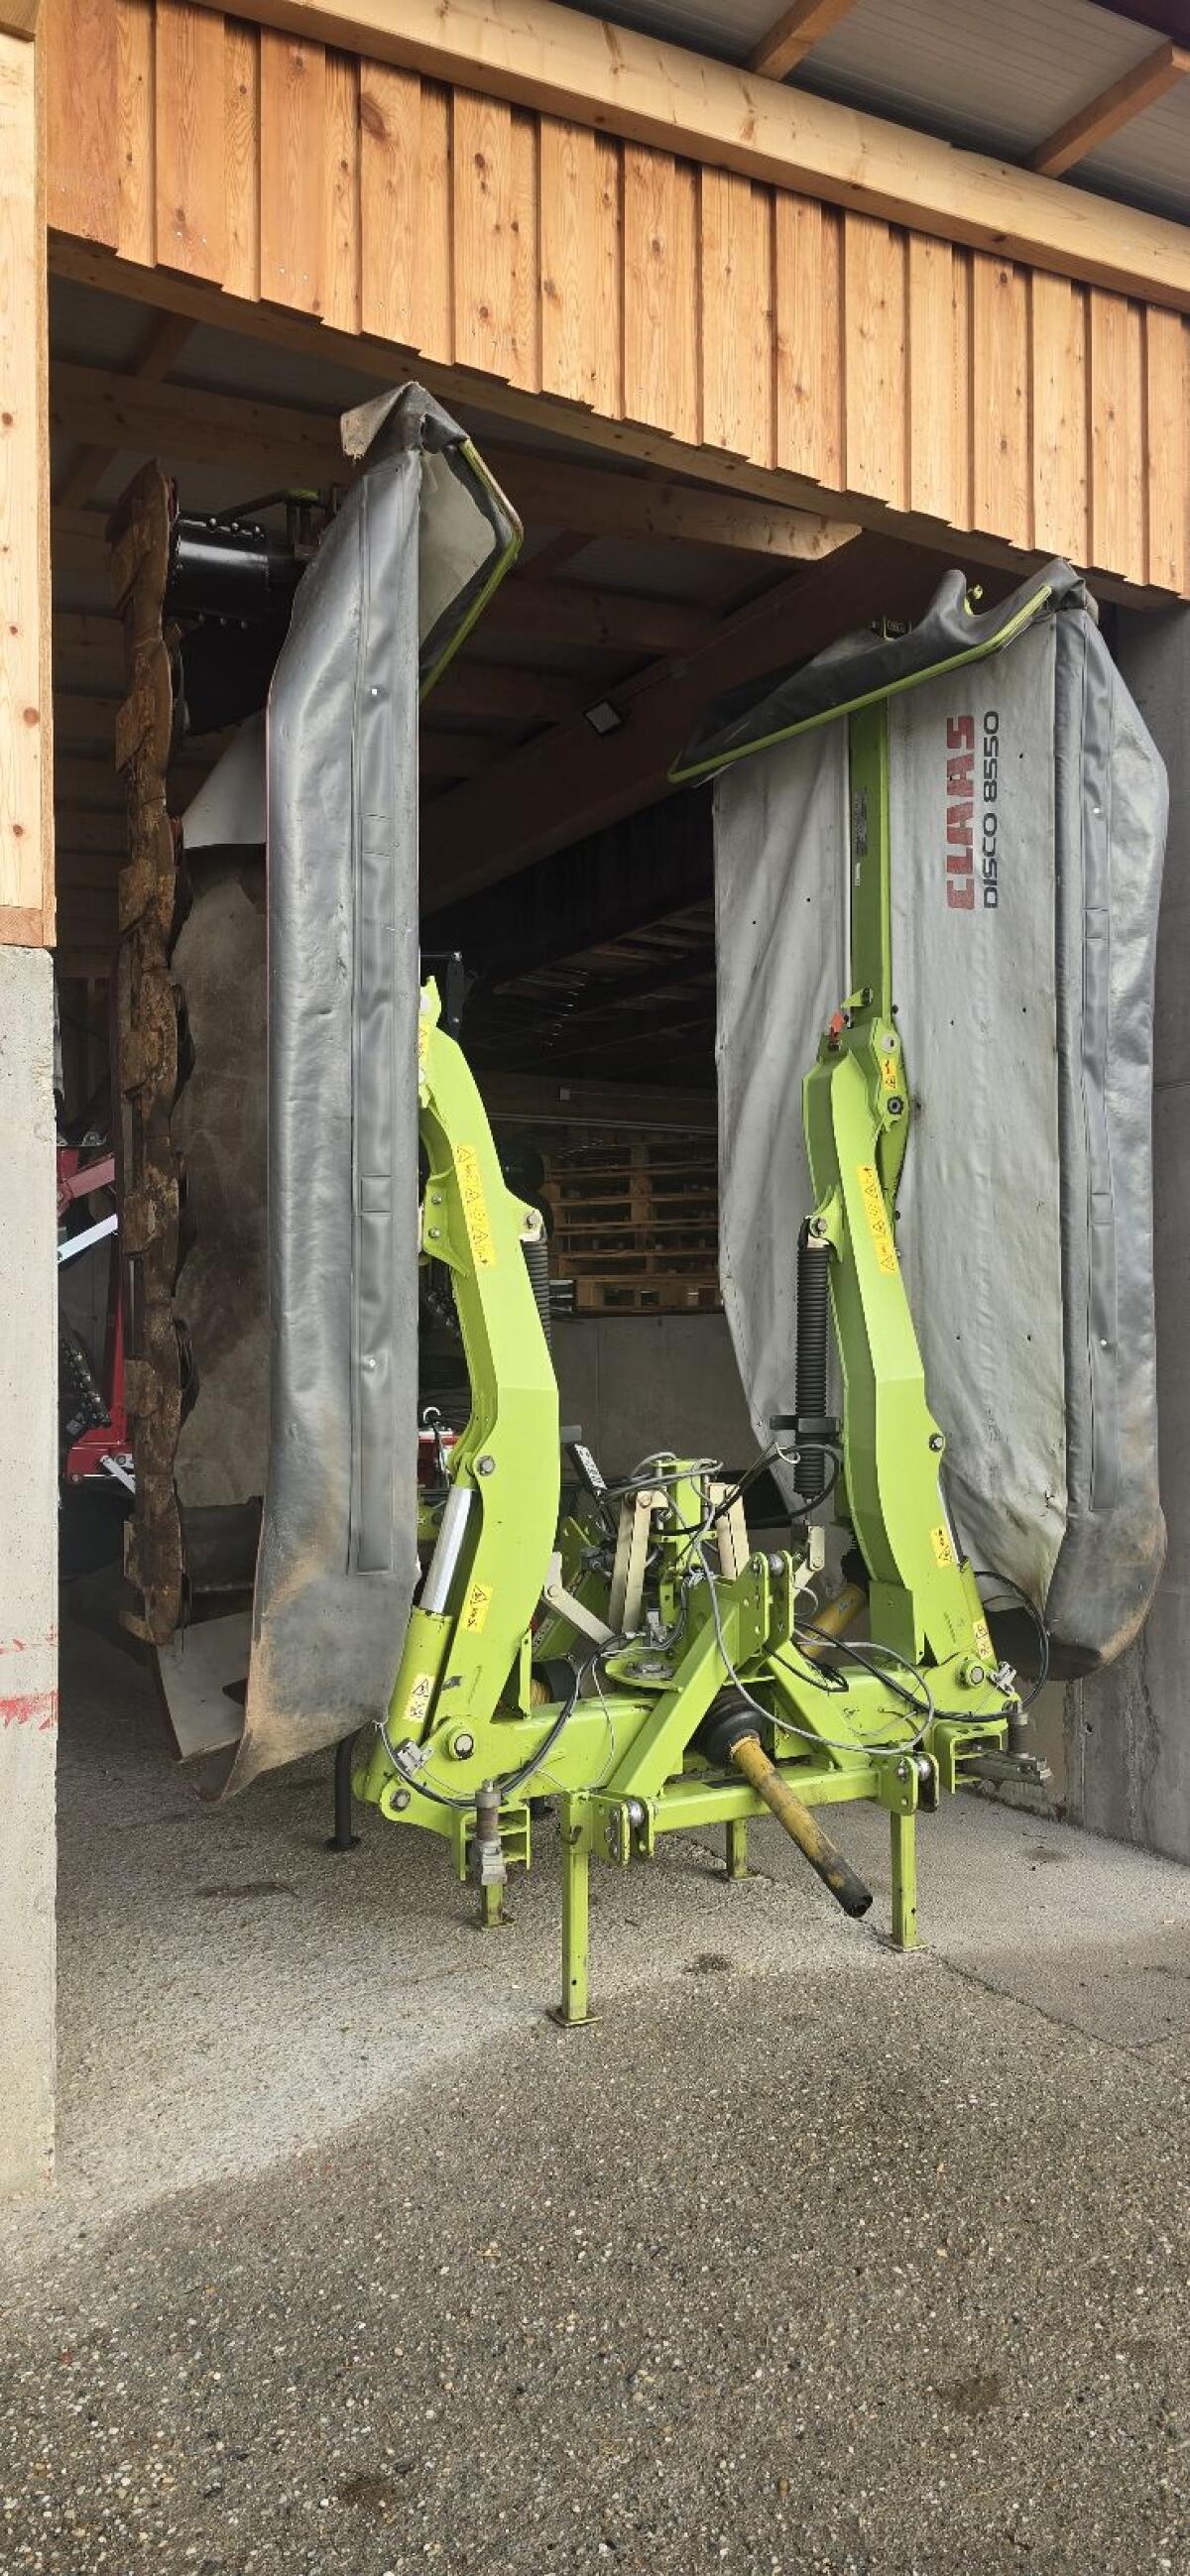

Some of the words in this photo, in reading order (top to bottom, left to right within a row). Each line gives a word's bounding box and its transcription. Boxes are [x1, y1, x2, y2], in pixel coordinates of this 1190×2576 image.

[983, 710, 1000, 803] 8550
[946, 714, 975, 910] CLAAS
[982, 812, 999, 909] DISCO
